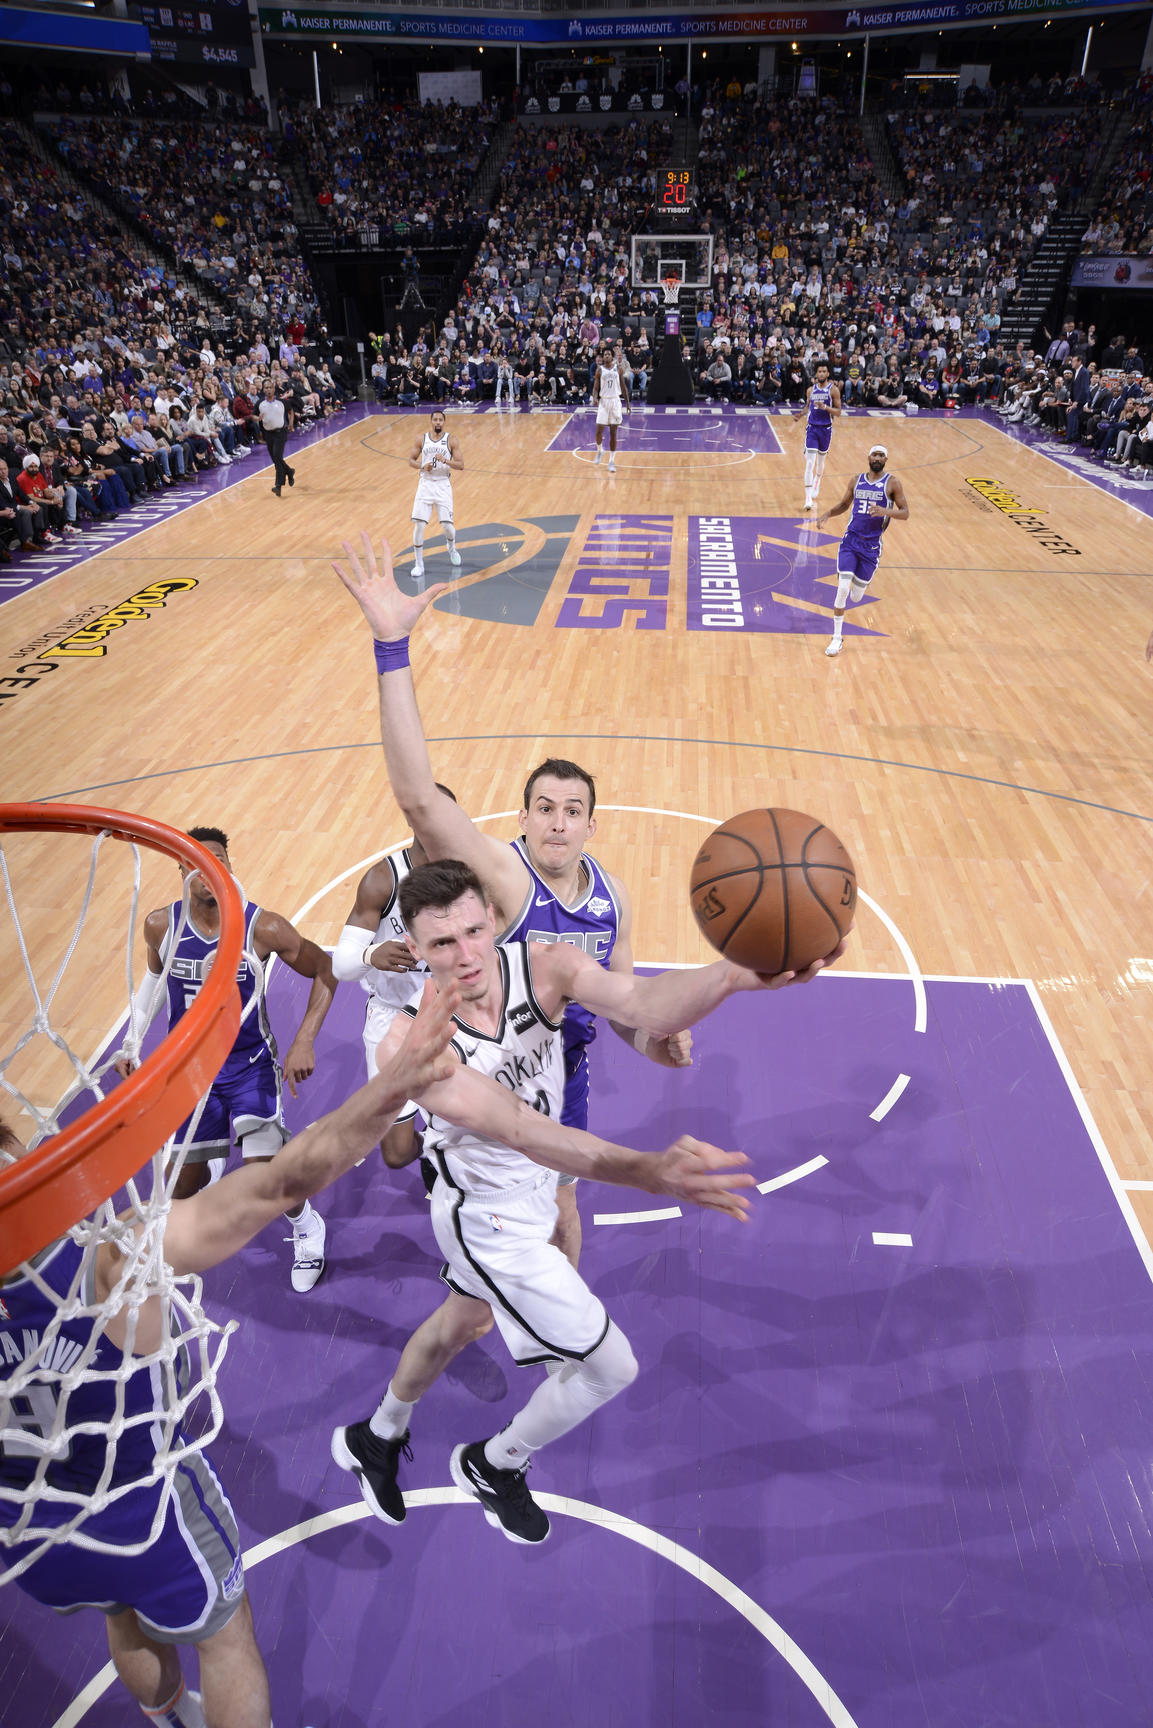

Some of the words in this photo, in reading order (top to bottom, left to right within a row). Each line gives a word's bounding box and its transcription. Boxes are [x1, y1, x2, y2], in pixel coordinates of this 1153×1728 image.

[863, 13, 893, 26] KAISER
[894, 6, 958, 23] PERMANENTE
[964, 1, 1006, 16] SPORTS
[300, 16, 331, 29] KAISER
[332, 18, 392, 32] PERMANENTE
[400, 22, 437, 34] SPORTS
[438, 23, 486, 36] MEDICINE
[487, 24, 525, 37] CENTER
[585, 24, 613, 36] KAISER
[615, 22, 672, 35] PERMANENTE
[680, 21, 716, 33] SPORTS
[718, 19, 767, 32] MEDICINE
[768, 18, 808, 31] CENTER
[202, 45, 239, 62] $4,545
[667, 171, 689, 184] 9:13
[663, 184, 686, 204] 20
[1008, 514, 1082, 555] CENTER
[554, 514, 674, 630] KINGS
[698, 517, 745, 627] SACRAMENTO
[8, 631, 68, 660] Union
[509, 1011, 533, 1029] infor
